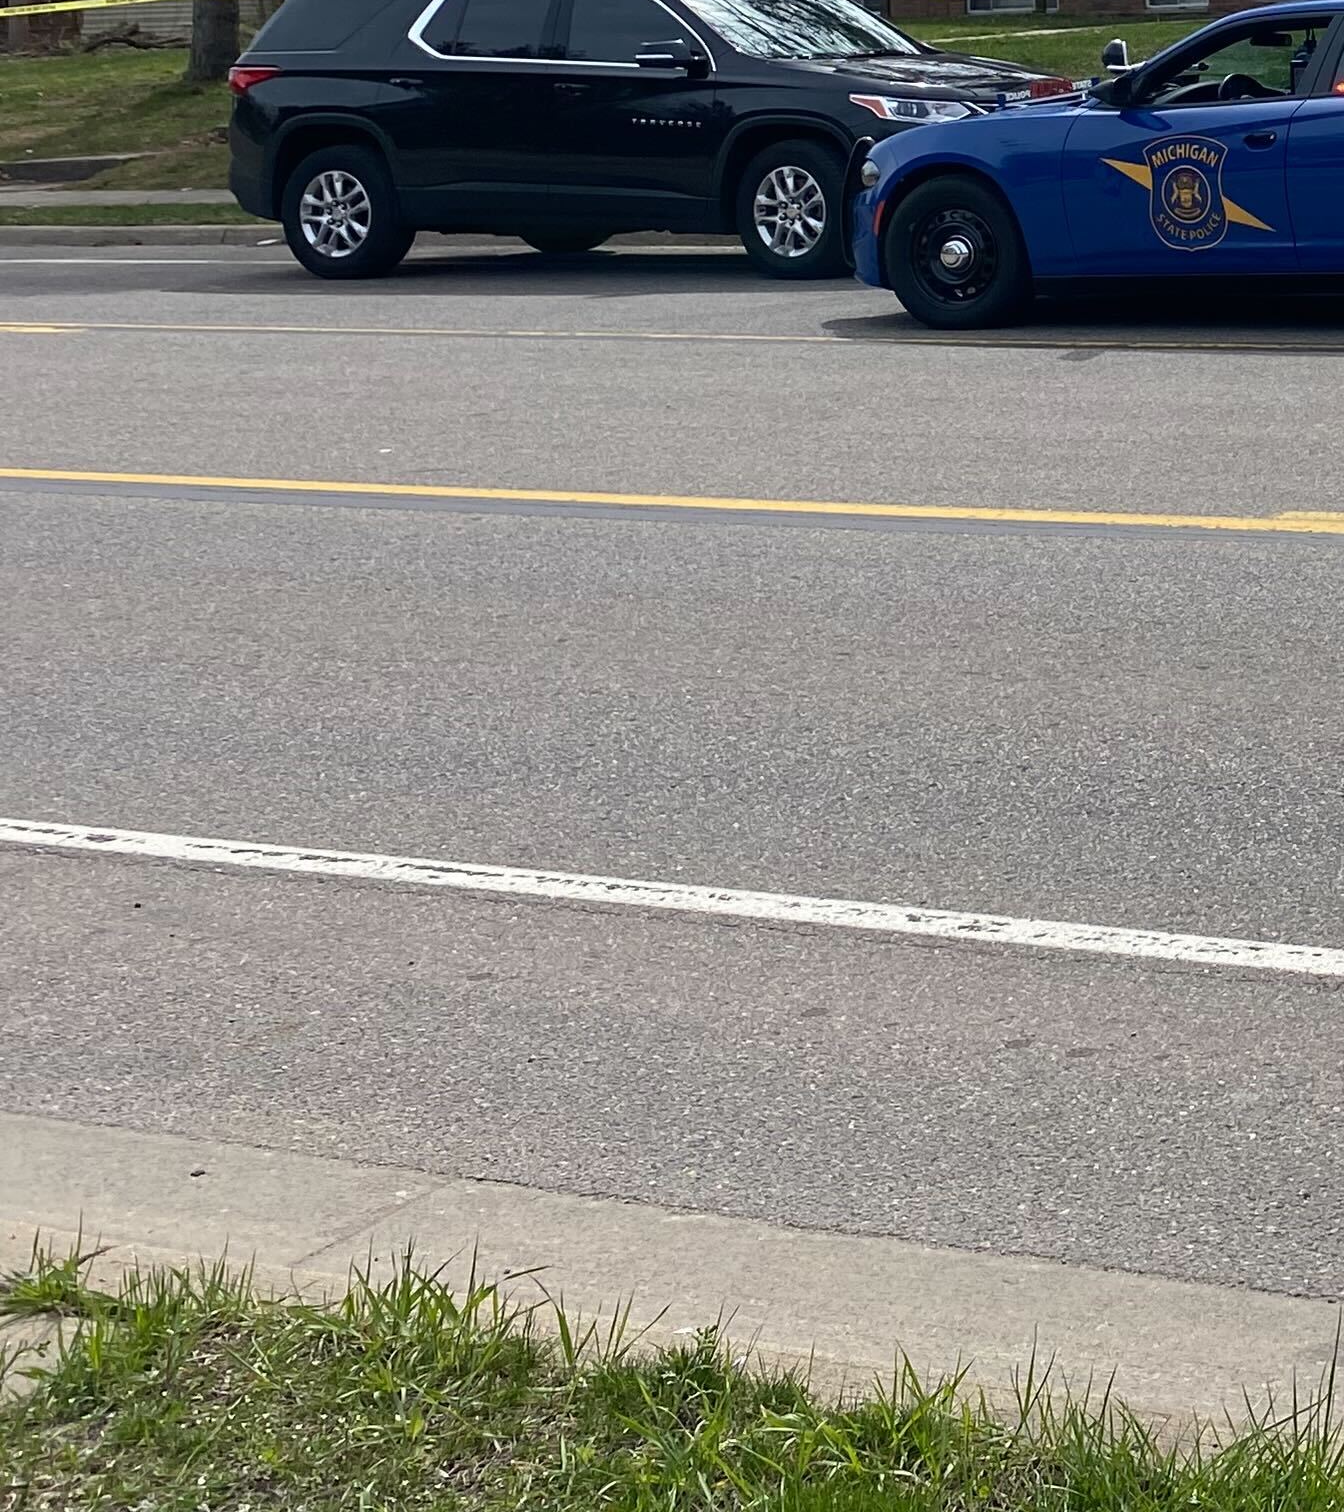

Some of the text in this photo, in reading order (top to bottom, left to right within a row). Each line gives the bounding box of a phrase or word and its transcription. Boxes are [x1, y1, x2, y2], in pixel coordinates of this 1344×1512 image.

[1151, 143, 1220, 169] MICHIGAN
[1157, 212, 1221, 240] STATE POLICE
